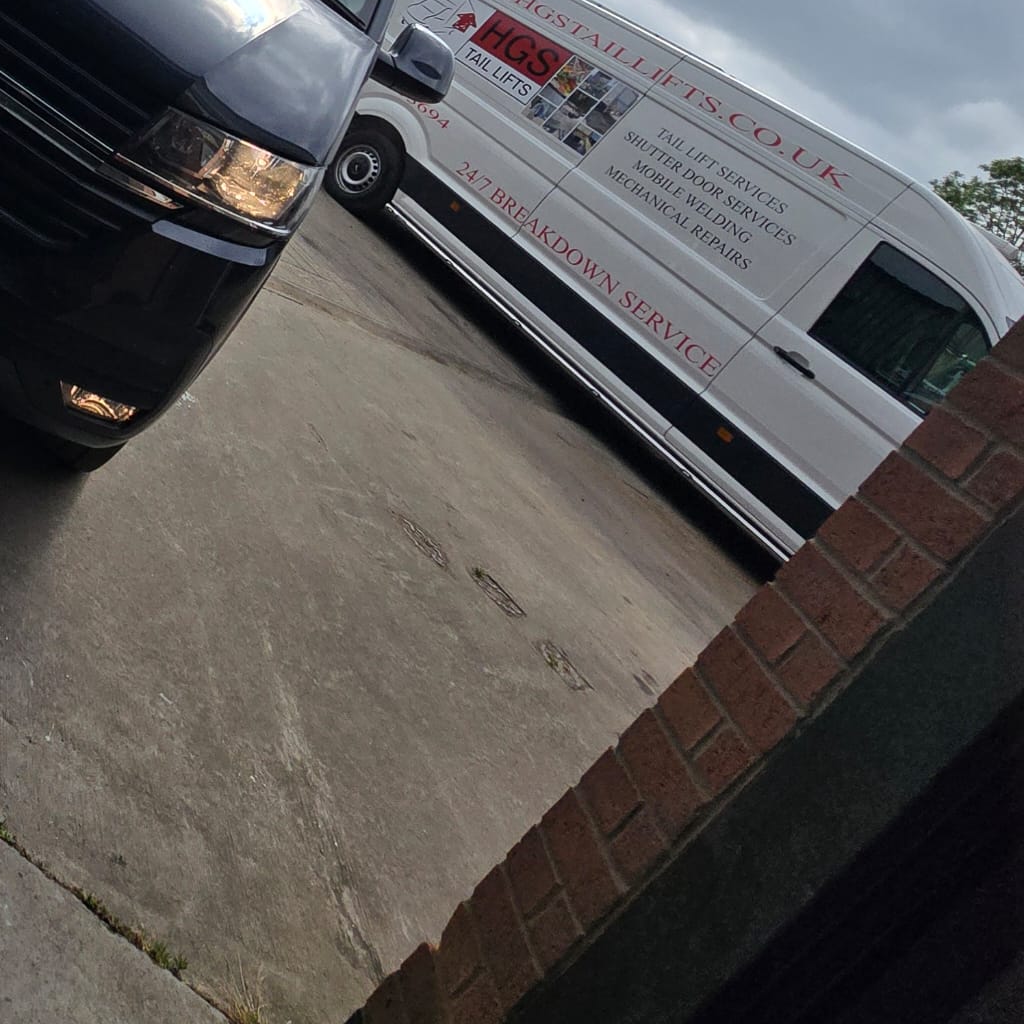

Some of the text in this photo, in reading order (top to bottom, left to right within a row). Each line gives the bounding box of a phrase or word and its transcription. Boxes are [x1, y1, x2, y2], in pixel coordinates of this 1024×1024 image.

[462, 47, 532, 97] TAIL LIFTS
[479, 19, 559, 77] HGS
[624, 130, 797, 247] SHUTTER DOOR SERVICES
[632, 159, 753, 244] MOBILE WELDING
[657, 128, 789, 215] TAIL LIFT SERVICES
[605, 165, 753, 271] MECHANICAL REPAIRS
[455, 161, 723, 377] 24/7 BREAKDOWN SERVICE
